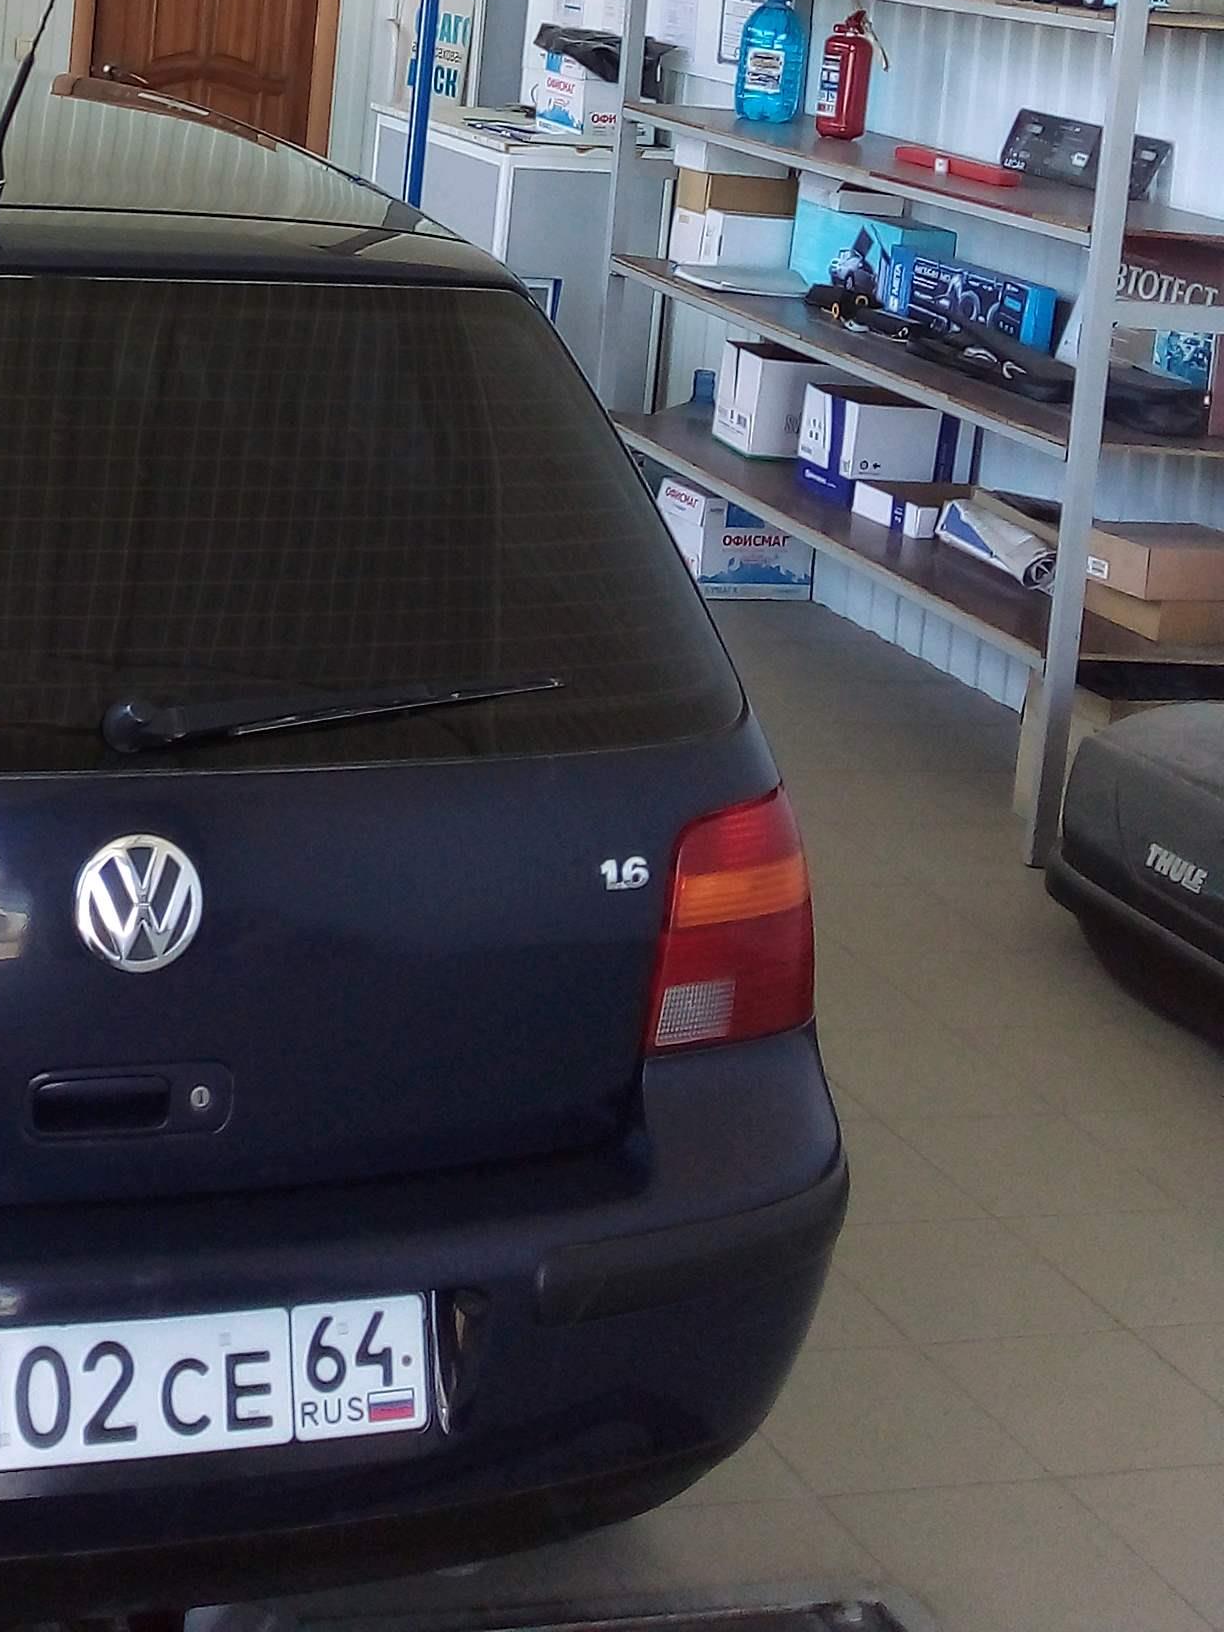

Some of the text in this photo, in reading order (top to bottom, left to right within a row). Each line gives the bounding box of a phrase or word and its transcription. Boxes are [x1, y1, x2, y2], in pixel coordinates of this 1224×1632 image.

[722, 534, 791, 548] ОФИСМАГ
[1145, 842, 1209, 895] THULE
[305, 1310, 394, 1394] 64
[300, 1395, 364, 1428] RUS
